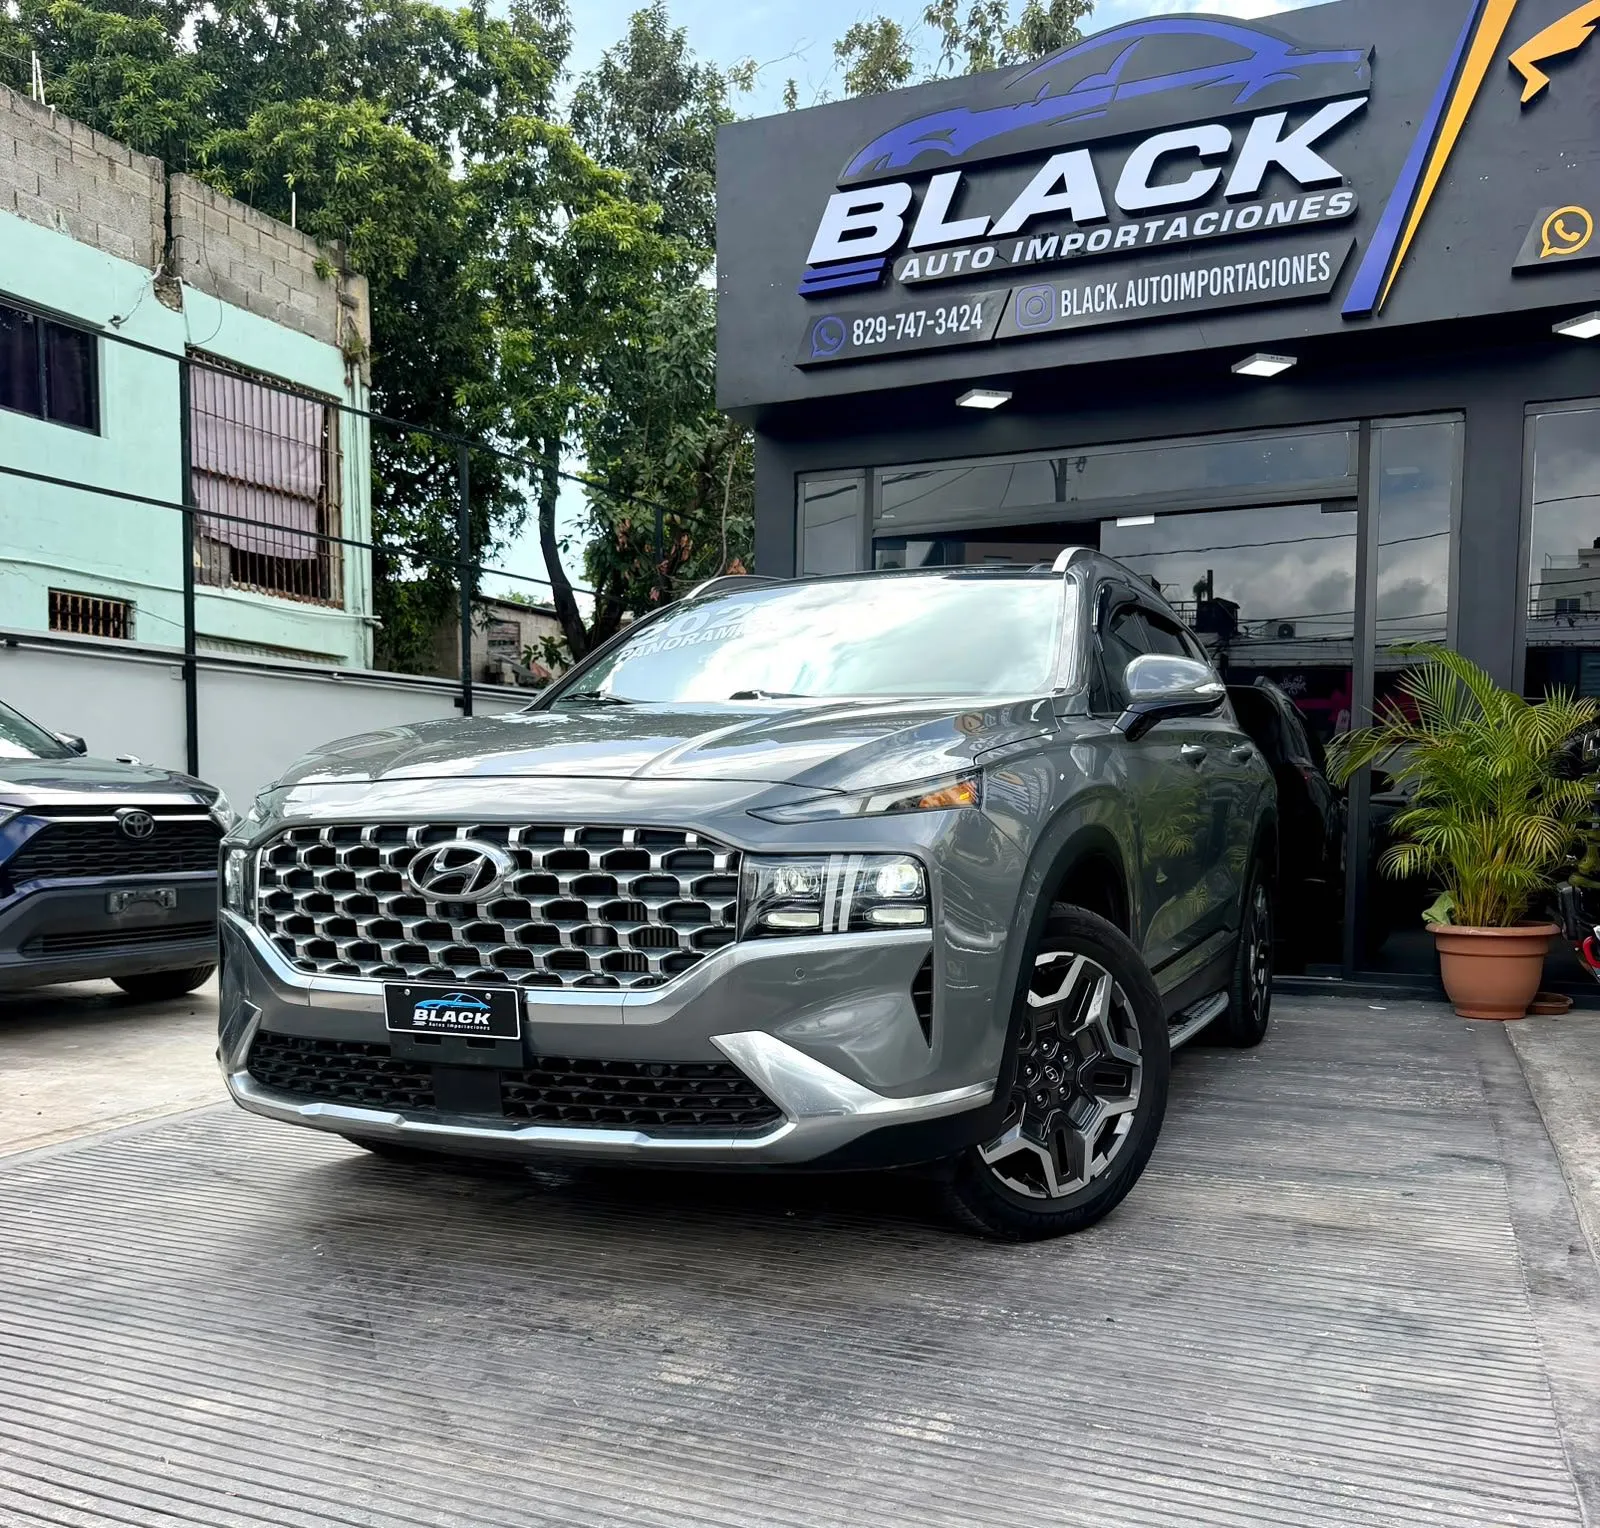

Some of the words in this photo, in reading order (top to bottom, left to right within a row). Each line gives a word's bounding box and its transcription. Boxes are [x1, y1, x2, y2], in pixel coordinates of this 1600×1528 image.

[806, 97, 1368, 264] BLACK
[898, 247, 994, 282] AUTO
[1011, 191, 1356, 264] IMPORTACIONES
[1060, 251, 1332, 318] BLACK.AUTOIMPORTACIONES
[851, 303, 984, 346] 829-747-3424
[413, 1008, 491, 1024] BLACK
